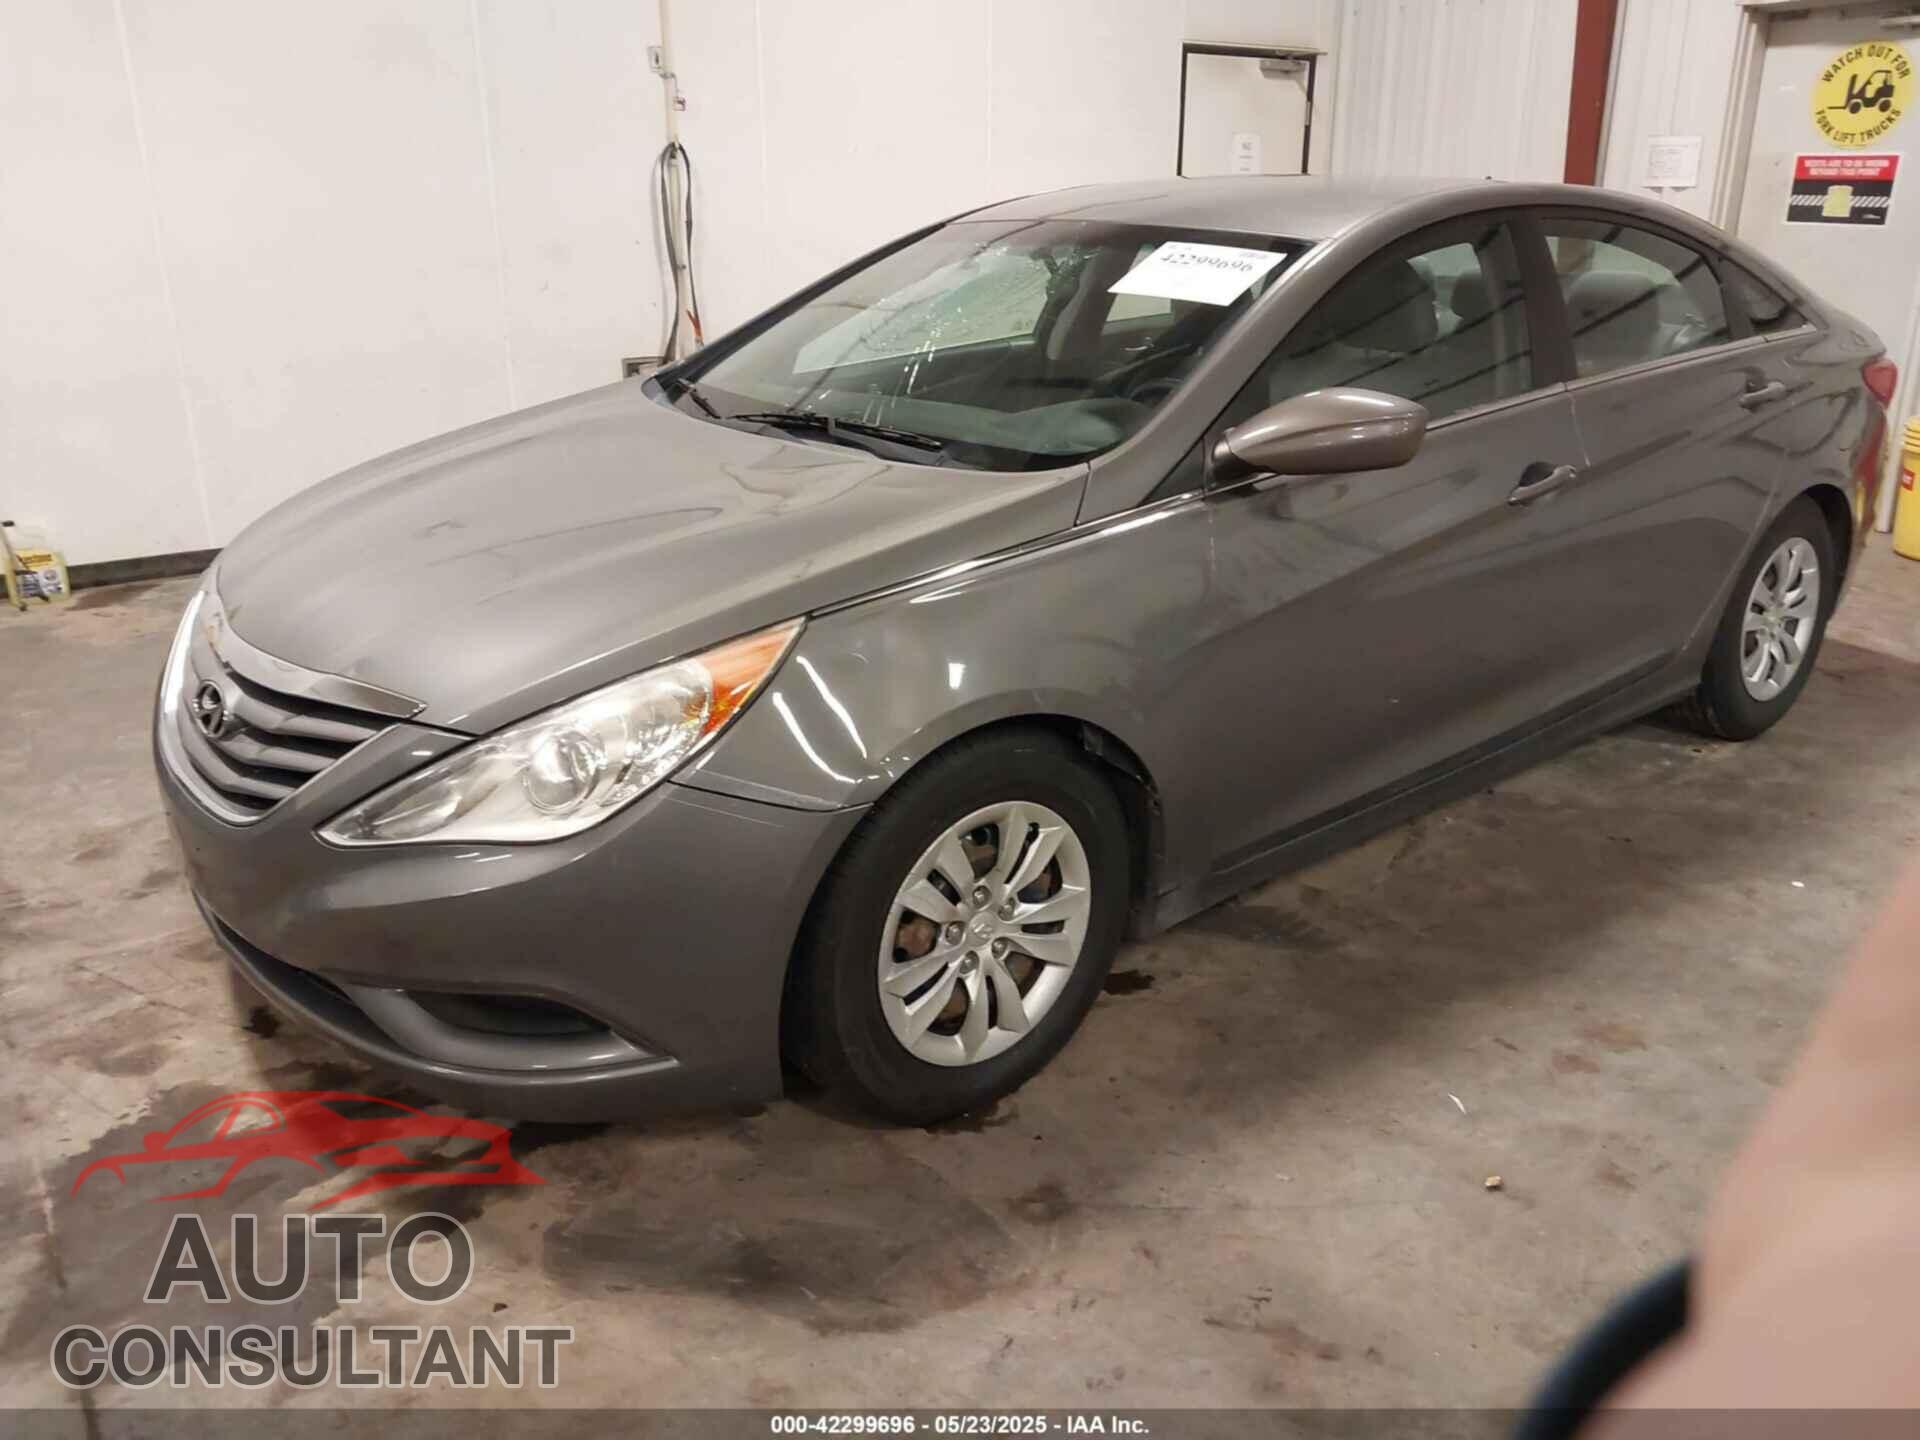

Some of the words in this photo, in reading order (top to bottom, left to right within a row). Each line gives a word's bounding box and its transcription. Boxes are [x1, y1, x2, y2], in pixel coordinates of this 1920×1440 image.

[1822, 47, 1863, 82] WATCH
[1867, 44, 1893, 60] OUT
[1891, 54, 1911, 79] FOR
[1833, 132, 1857, 143] LIFT
[1860, 108, 1901, 142] TRUCKS
[1160, 253, 1253, 272] 42299696
